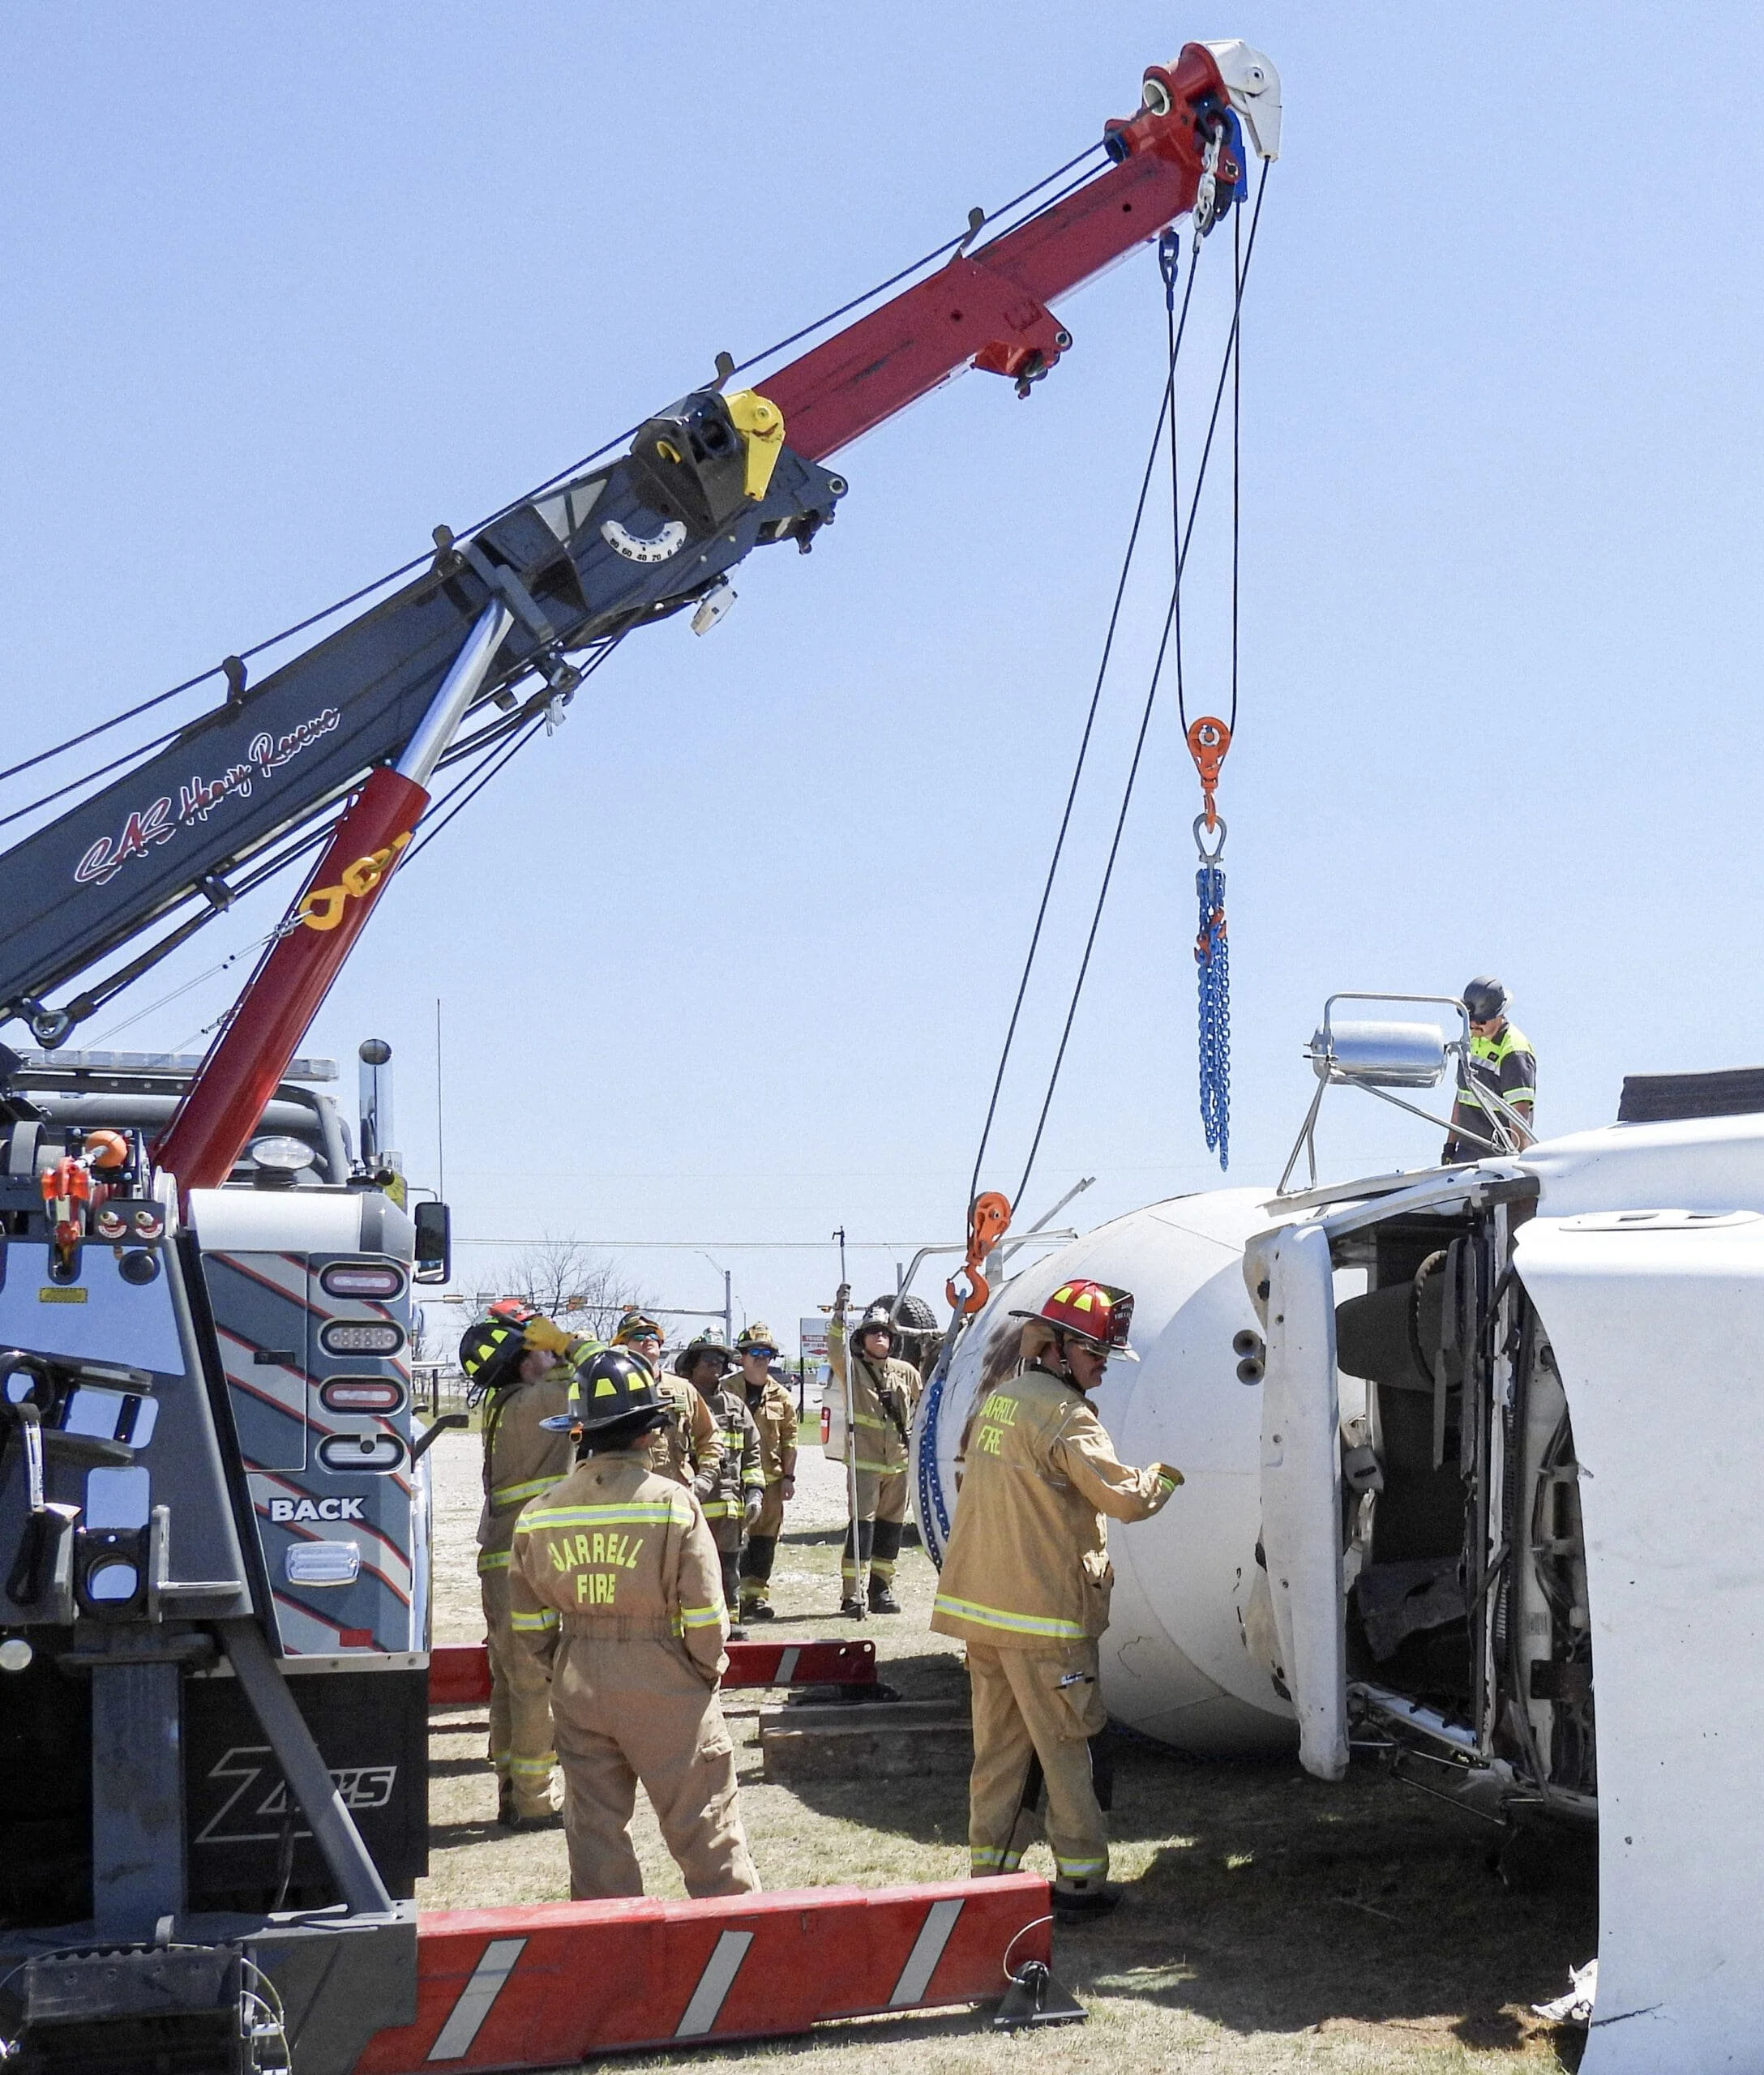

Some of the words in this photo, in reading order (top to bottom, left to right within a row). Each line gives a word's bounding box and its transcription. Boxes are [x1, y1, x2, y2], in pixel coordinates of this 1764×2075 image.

[622, 548, 632, 557] 60
[178, 764, 252, 826] Heavy
[249, 708, 340, 777] Rescue
[270, 1496, 366, 1522] BACK
[549, 1532, 644, 1572] JARRELL
[576, 1573, 616, 1604] FIRE
